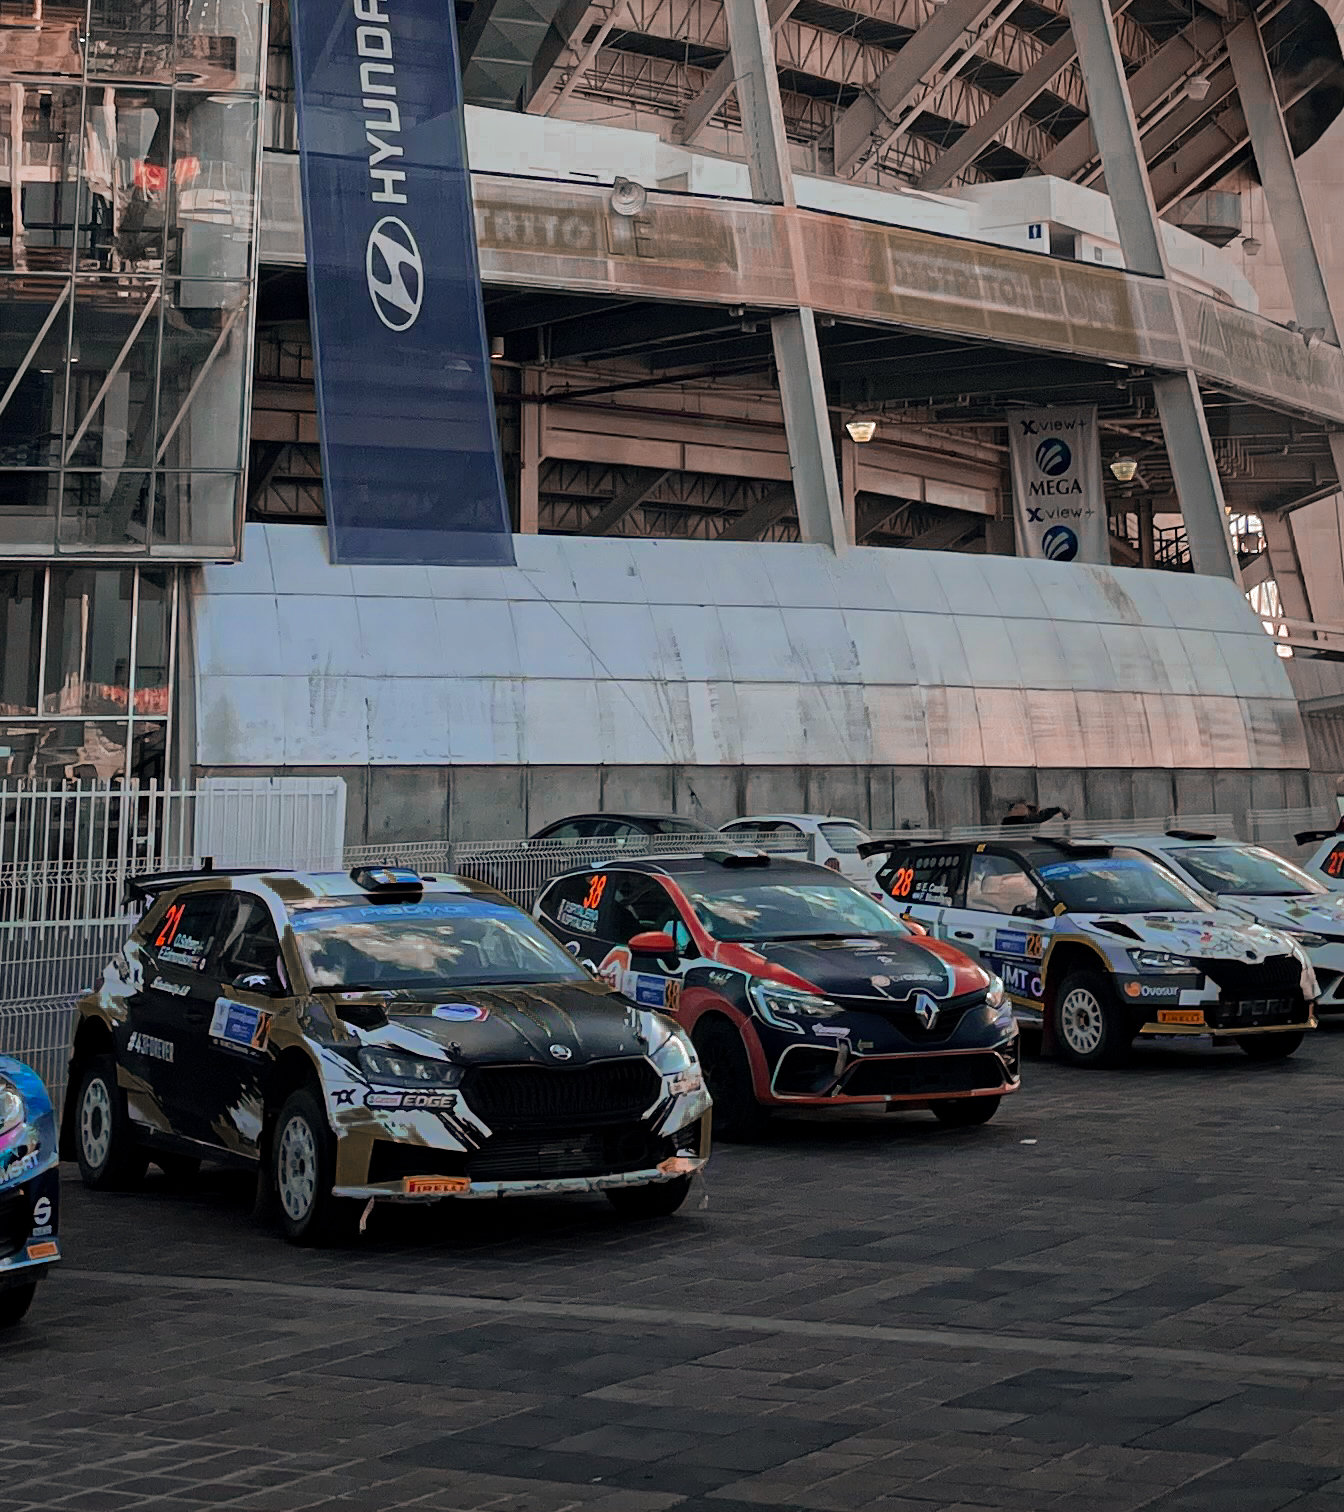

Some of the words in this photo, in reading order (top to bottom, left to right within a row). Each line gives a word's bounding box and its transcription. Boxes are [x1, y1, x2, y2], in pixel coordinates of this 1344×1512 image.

[1029, 479, 1083, 497] MEGA
[582, 874, 608, 910] 38
[891, 867, 915, 897] 28
[154, 903, 187, 947] 21
[1141, 986, 1180, 998] Ovosur
[402, 1095, 453, 1109] EDGE
